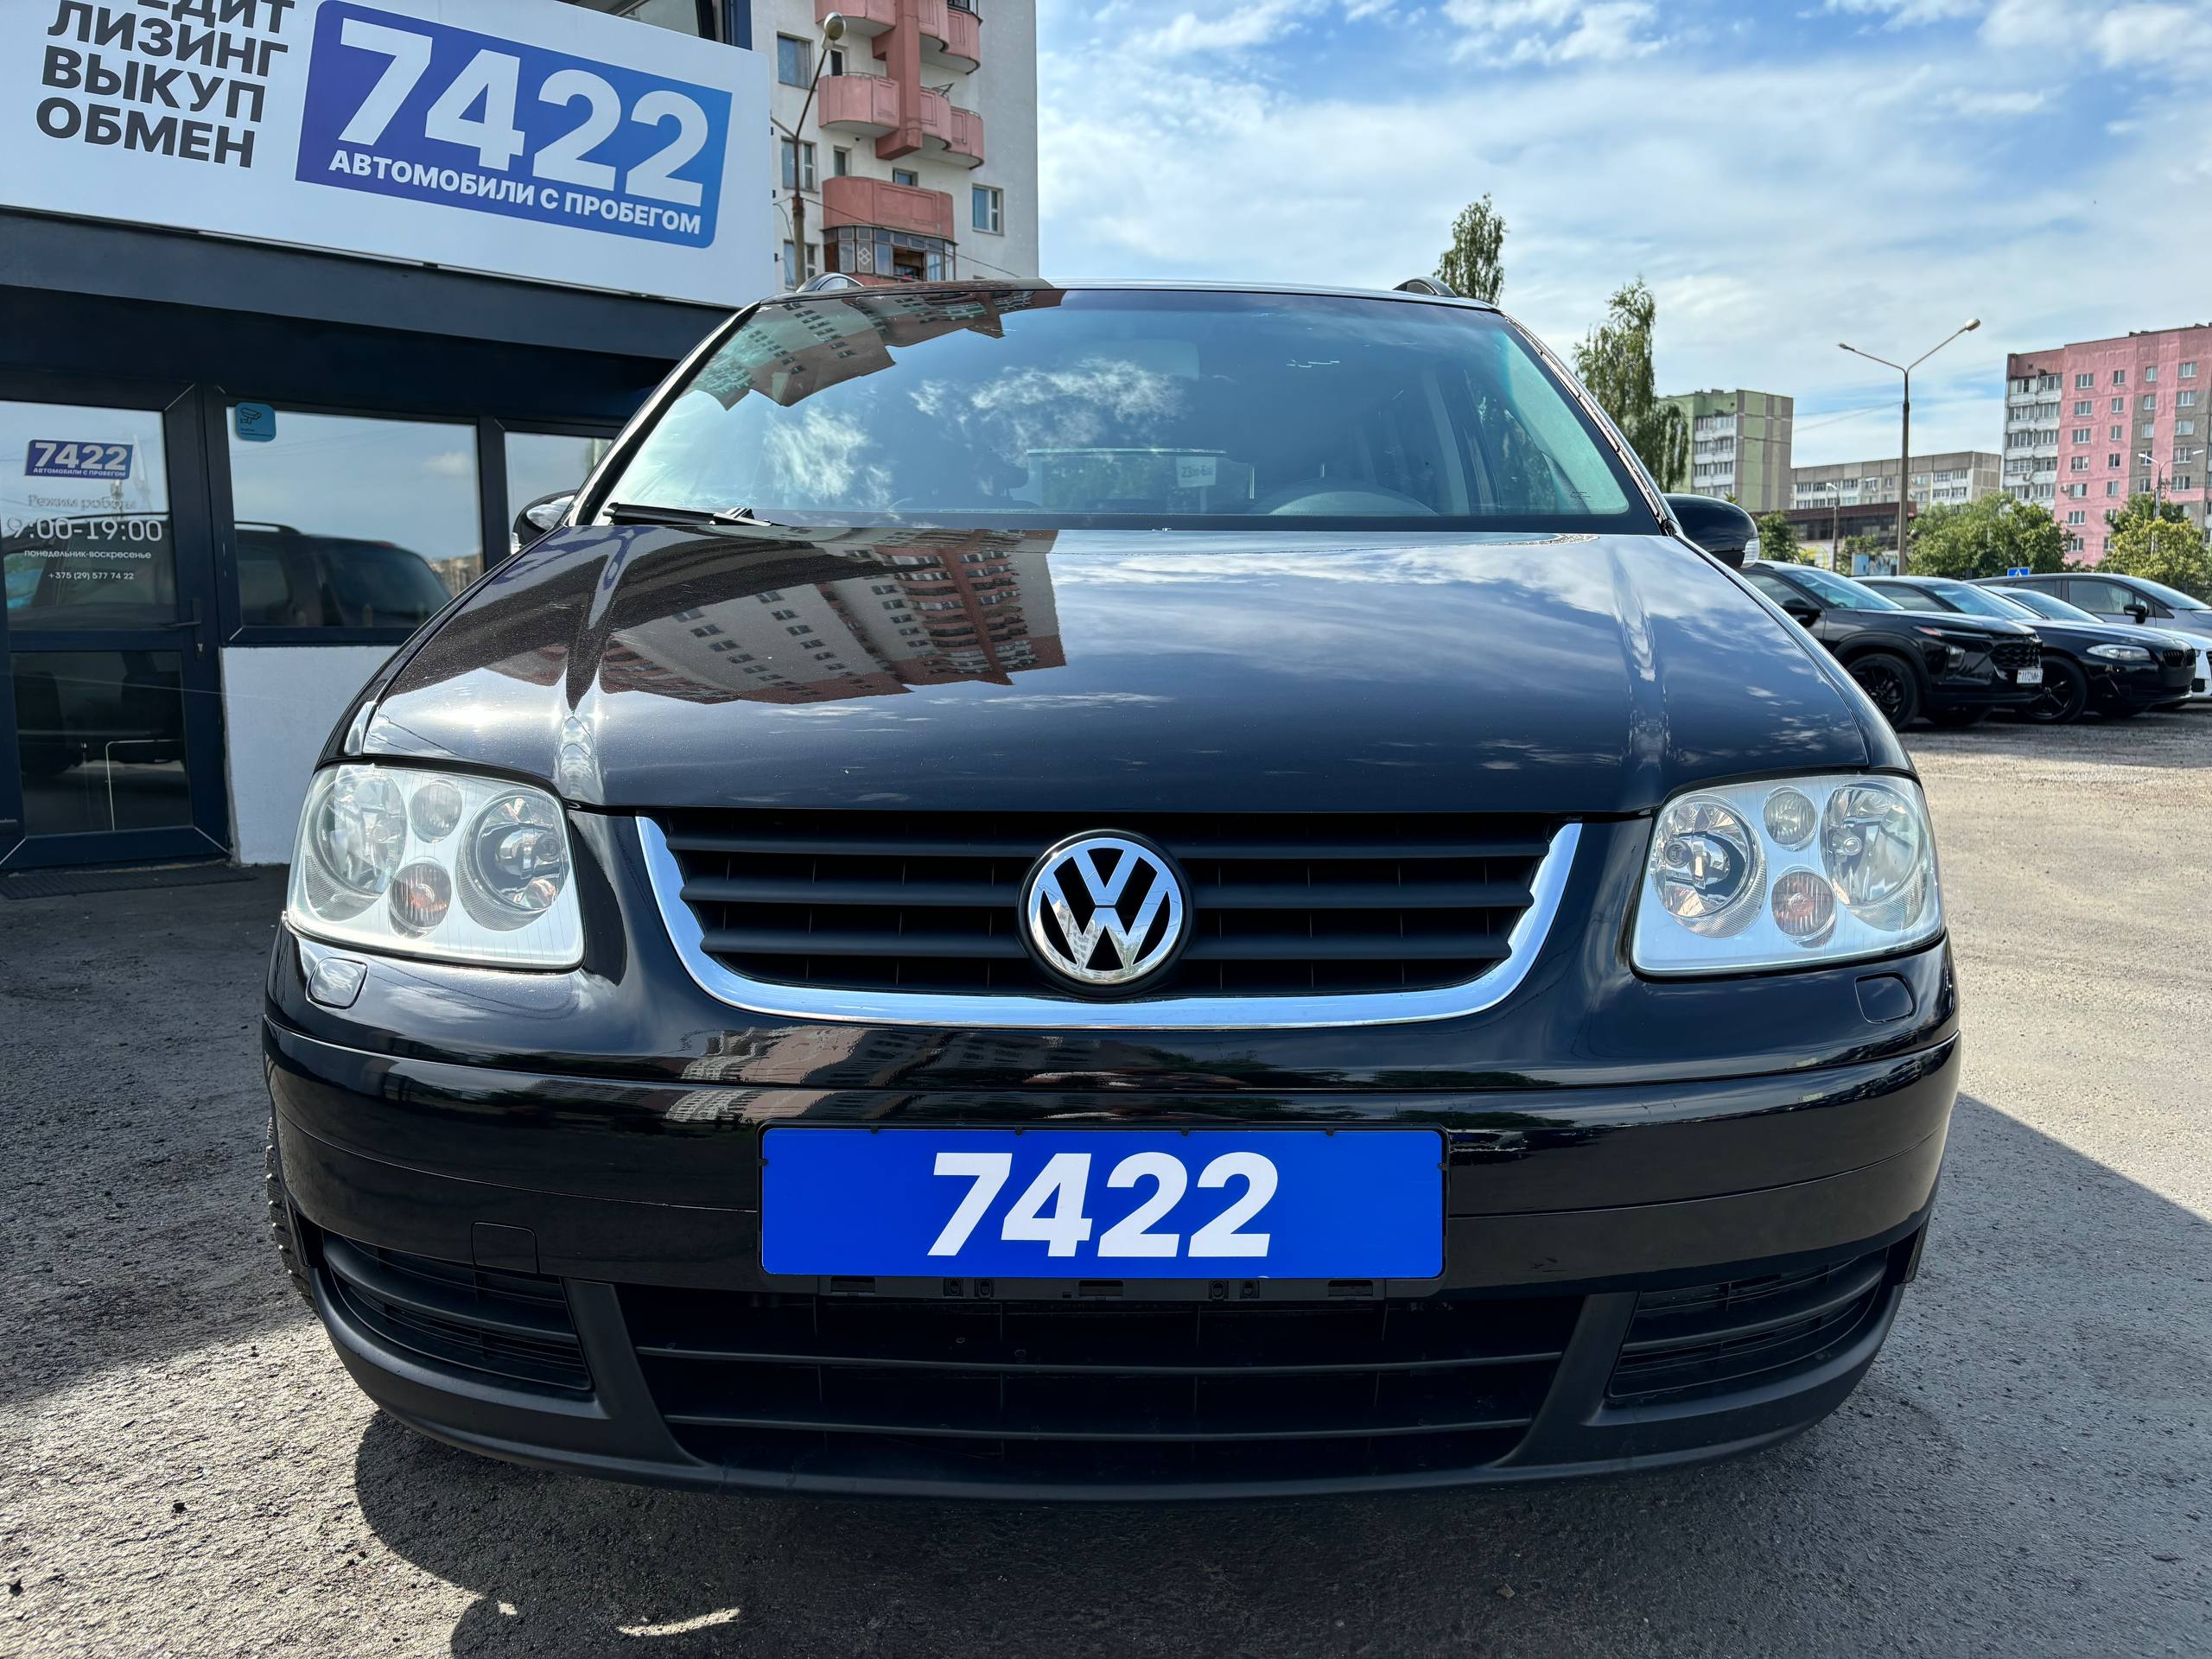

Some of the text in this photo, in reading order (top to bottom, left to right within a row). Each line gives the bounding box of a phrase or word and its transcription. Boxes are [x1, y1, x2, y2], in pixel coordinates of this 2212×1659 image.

[47, 0, 289, 77] ЛИЗИНГ
[137, 0, 296, 34] ДИТ
[41, 45, 265, 123] ВЫКУП
[338, 17, 709, 207] 7422
[35, 97, 256, 168] ОБМЕН
[328, 149, 702, 235] АВТОМОБИЛИ С ПРОБЕГОМ
[35, 442, 127, 471] 7422
[7, 517, 163, 542] 9:00-19:00
[24, 550, 152, 560] понедельник-воскресенье
[73, 571, 91, 581] (29)
[927, 1151, 1279, 1258] 7422
